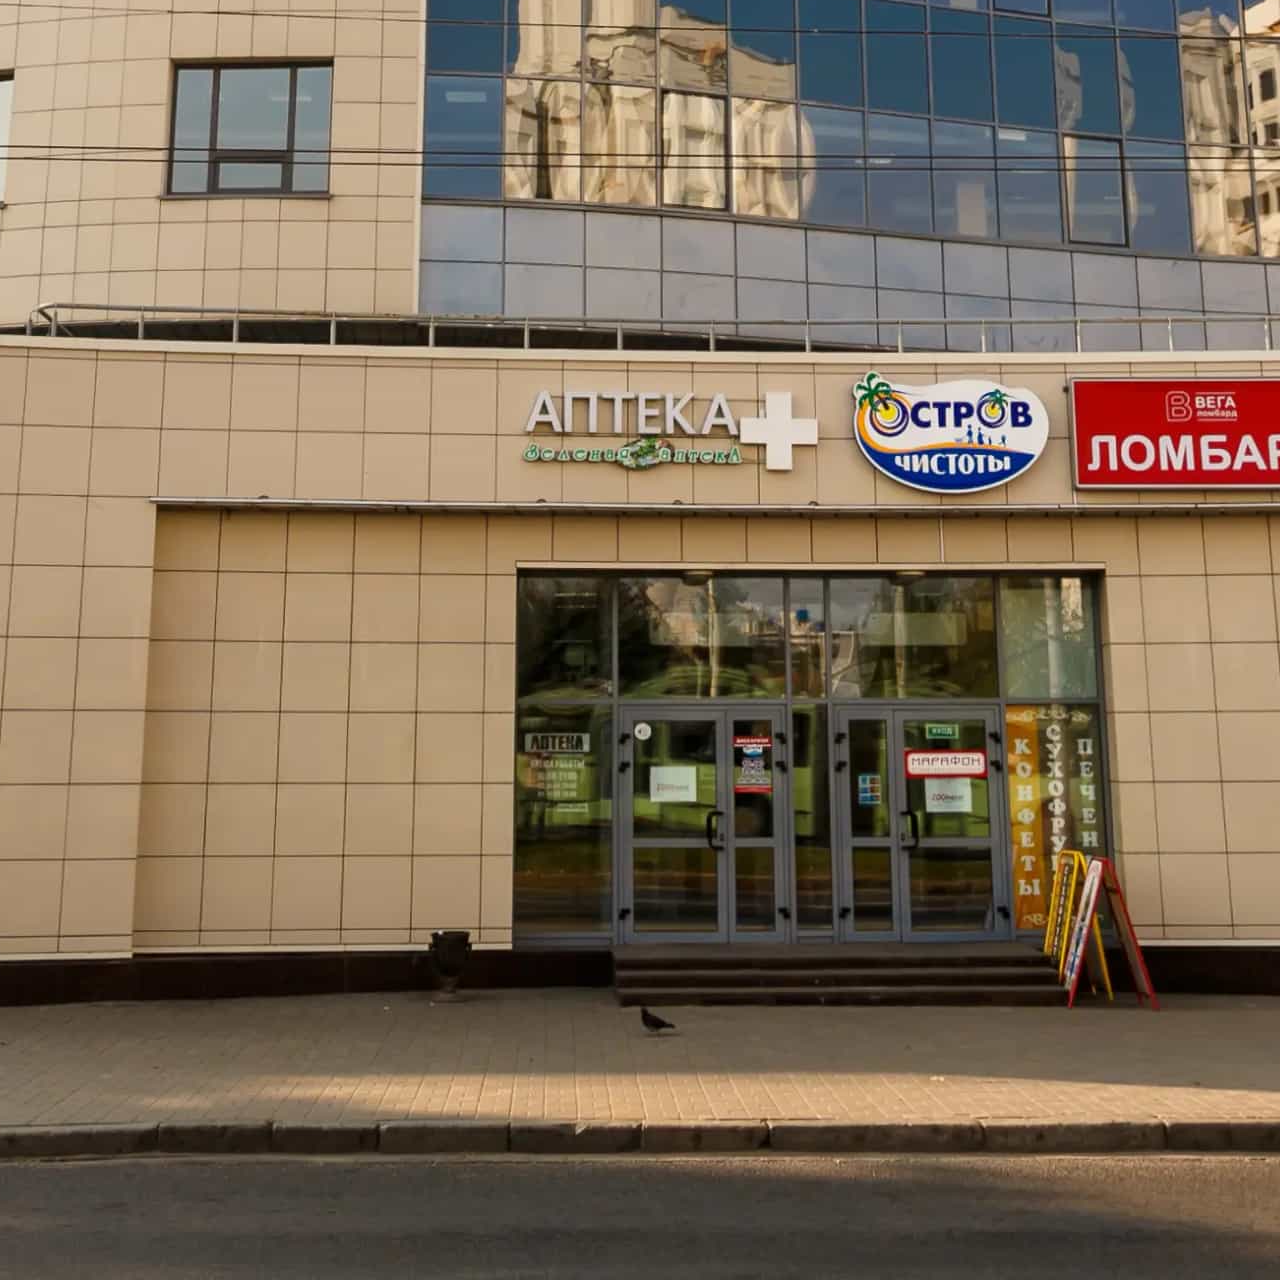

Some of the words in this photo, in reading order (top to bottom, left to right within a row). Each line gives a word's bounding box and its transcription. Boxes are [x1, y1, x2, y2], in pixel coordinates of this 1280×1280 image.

[525, 390, 740, 435] АПТЕКА
[869, 393, 1033, 438] ОСТРОВ
[1195, 395, 1236, 409] ВЕГА
[894, 453, 1012, 475] ЧИСТОТЫ
[530, 735, 585, 750] АПТЕКА
[911, 755, 981, 768] МАРАФОН
[1014, 738, 1041, 896] КОНФЕТЫ
[1045, 723, 1068, 874] СУХОФРУ
[1076, 738, 1099, 860] ПЕЧЕН
